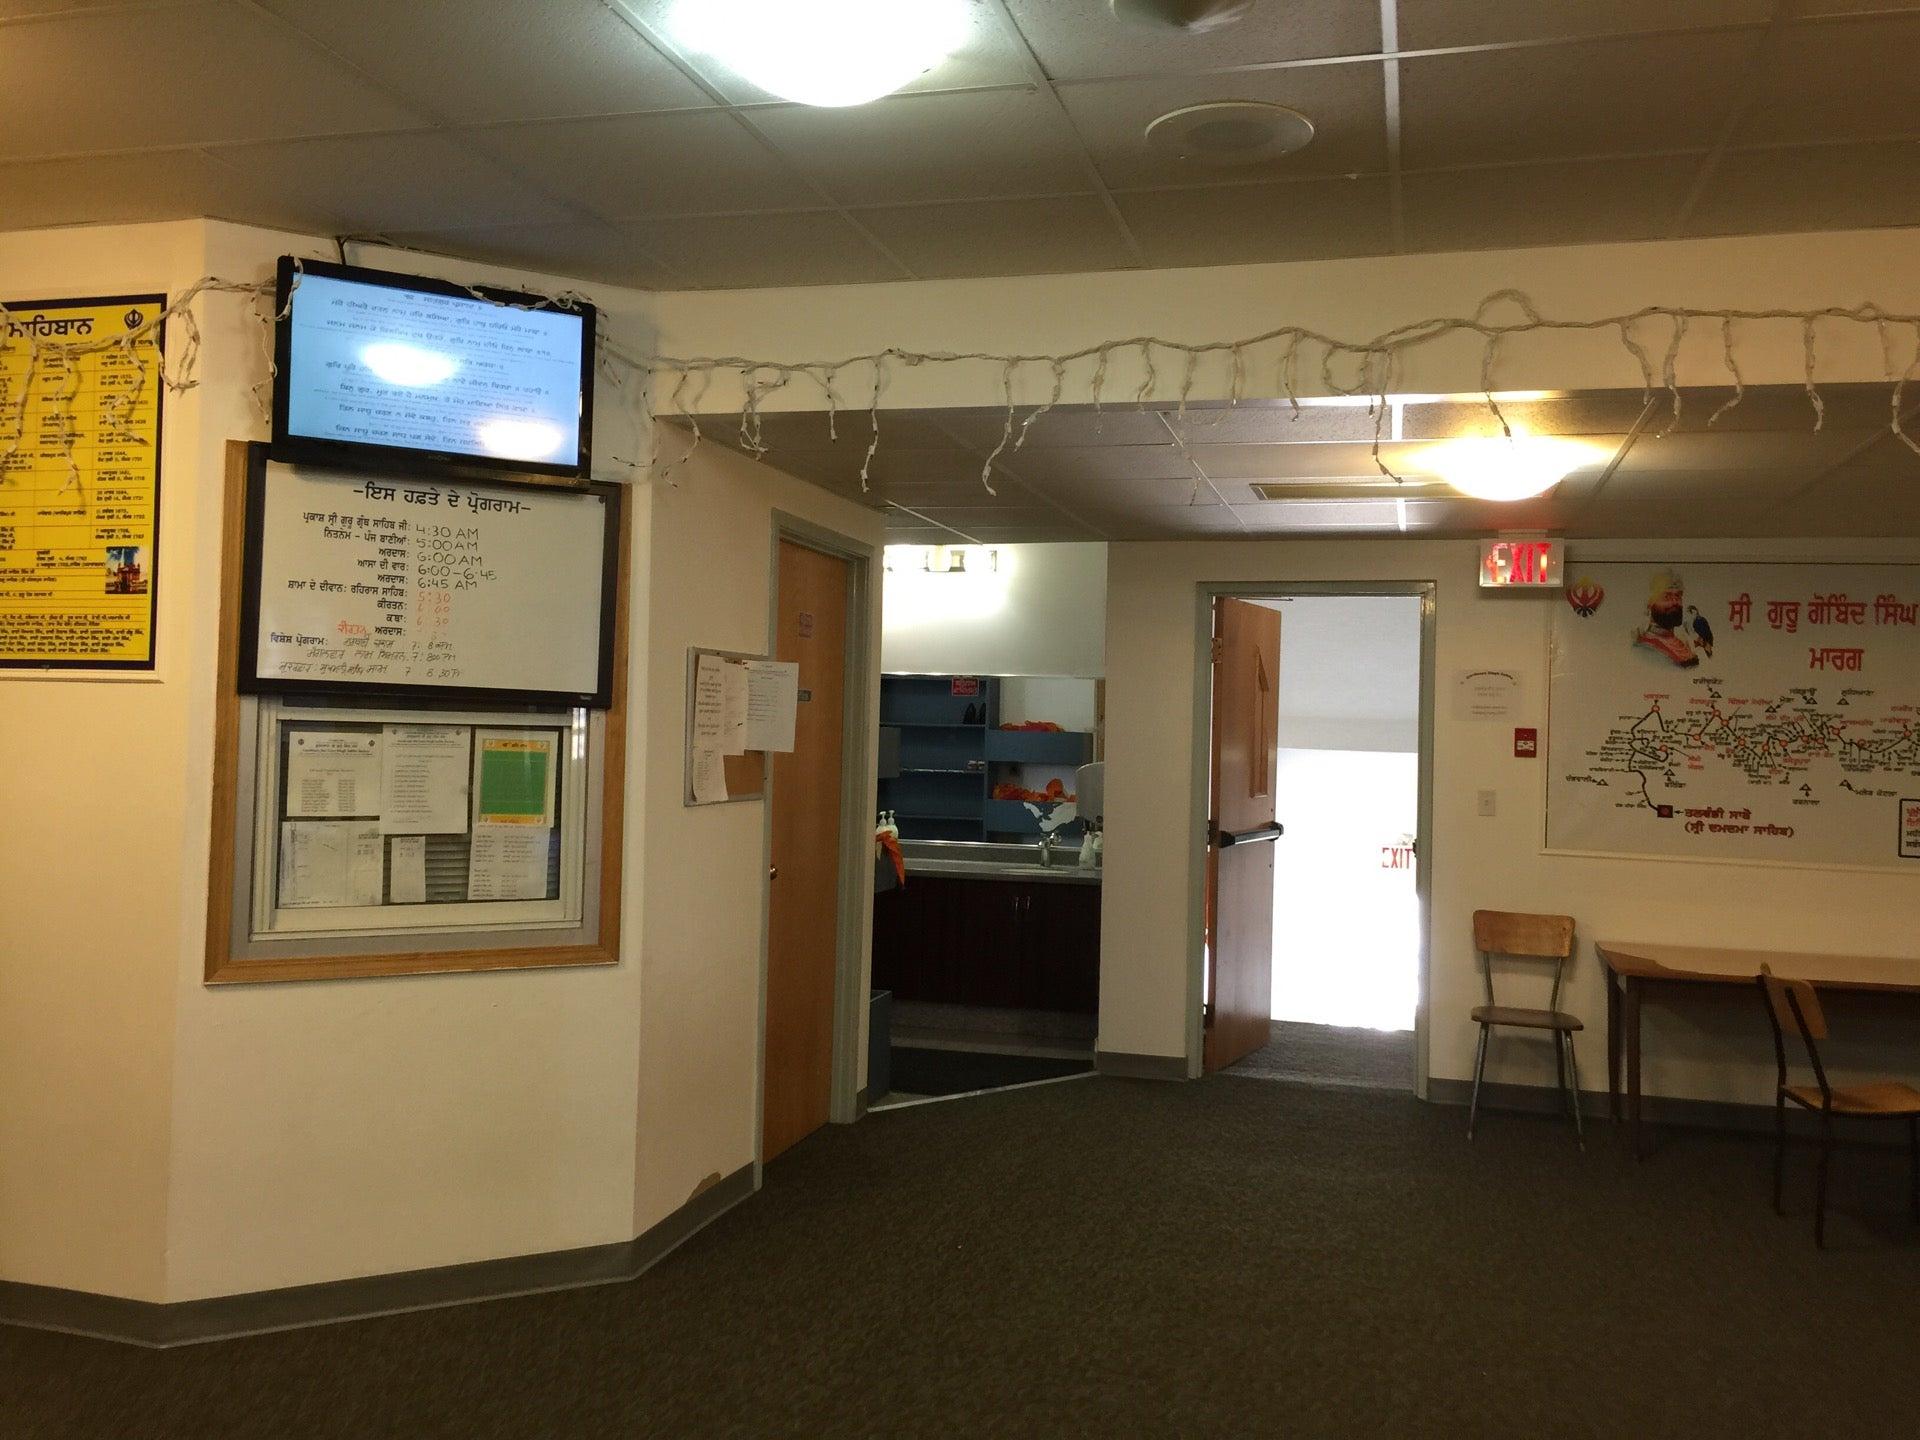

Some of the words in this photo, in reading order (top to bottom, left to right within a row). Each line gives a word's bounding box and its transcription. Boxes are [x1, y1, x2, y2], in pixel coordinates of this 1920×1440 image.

[448, 489, 460, 508] ਦੇ
[373, 517, 396, 530] ਸਾਹਿਬ
[324, 526, 351, 540] ਨਿਤਨੇਮ
[416, 524, 451, 538] 4:30
[456, 528, 479, 540] AM
[379, 548, 410, 559] ਅਰਦਾਸ:
[417, 552, 456, 566] 6:00
[458, 555, 482, 567] AM
[357, 559, 376, 570] ਆਸਾ
[379, 558, 389, 571] ਦੀ
[1491, 543, 1552, 583] EXIT
[377, 574, 409, 585] ਅਰਦਾਸ:
[418, 578, 449, 589] 6:45
[455, 580, 477, 591] AM
[309, 578, 316, 591] ਦੇ
[350, 583, 379, 596] ਰਹਿਰਾਸ
[1728, 592, 1752, 631] ਸ੍ਰੀ
[1767, 601, 1800, 633] ਗੁਰੂ
[1808, 592, 1868, 625] ਗੋਬਿੰਦ
[1873, 593, 1919, 626] ਸਿੰਘ
[374, 626, 406, 637] ਅਰਦਾਸ:
[1809, 648, 1864, 671] ਮਾਰਗ
